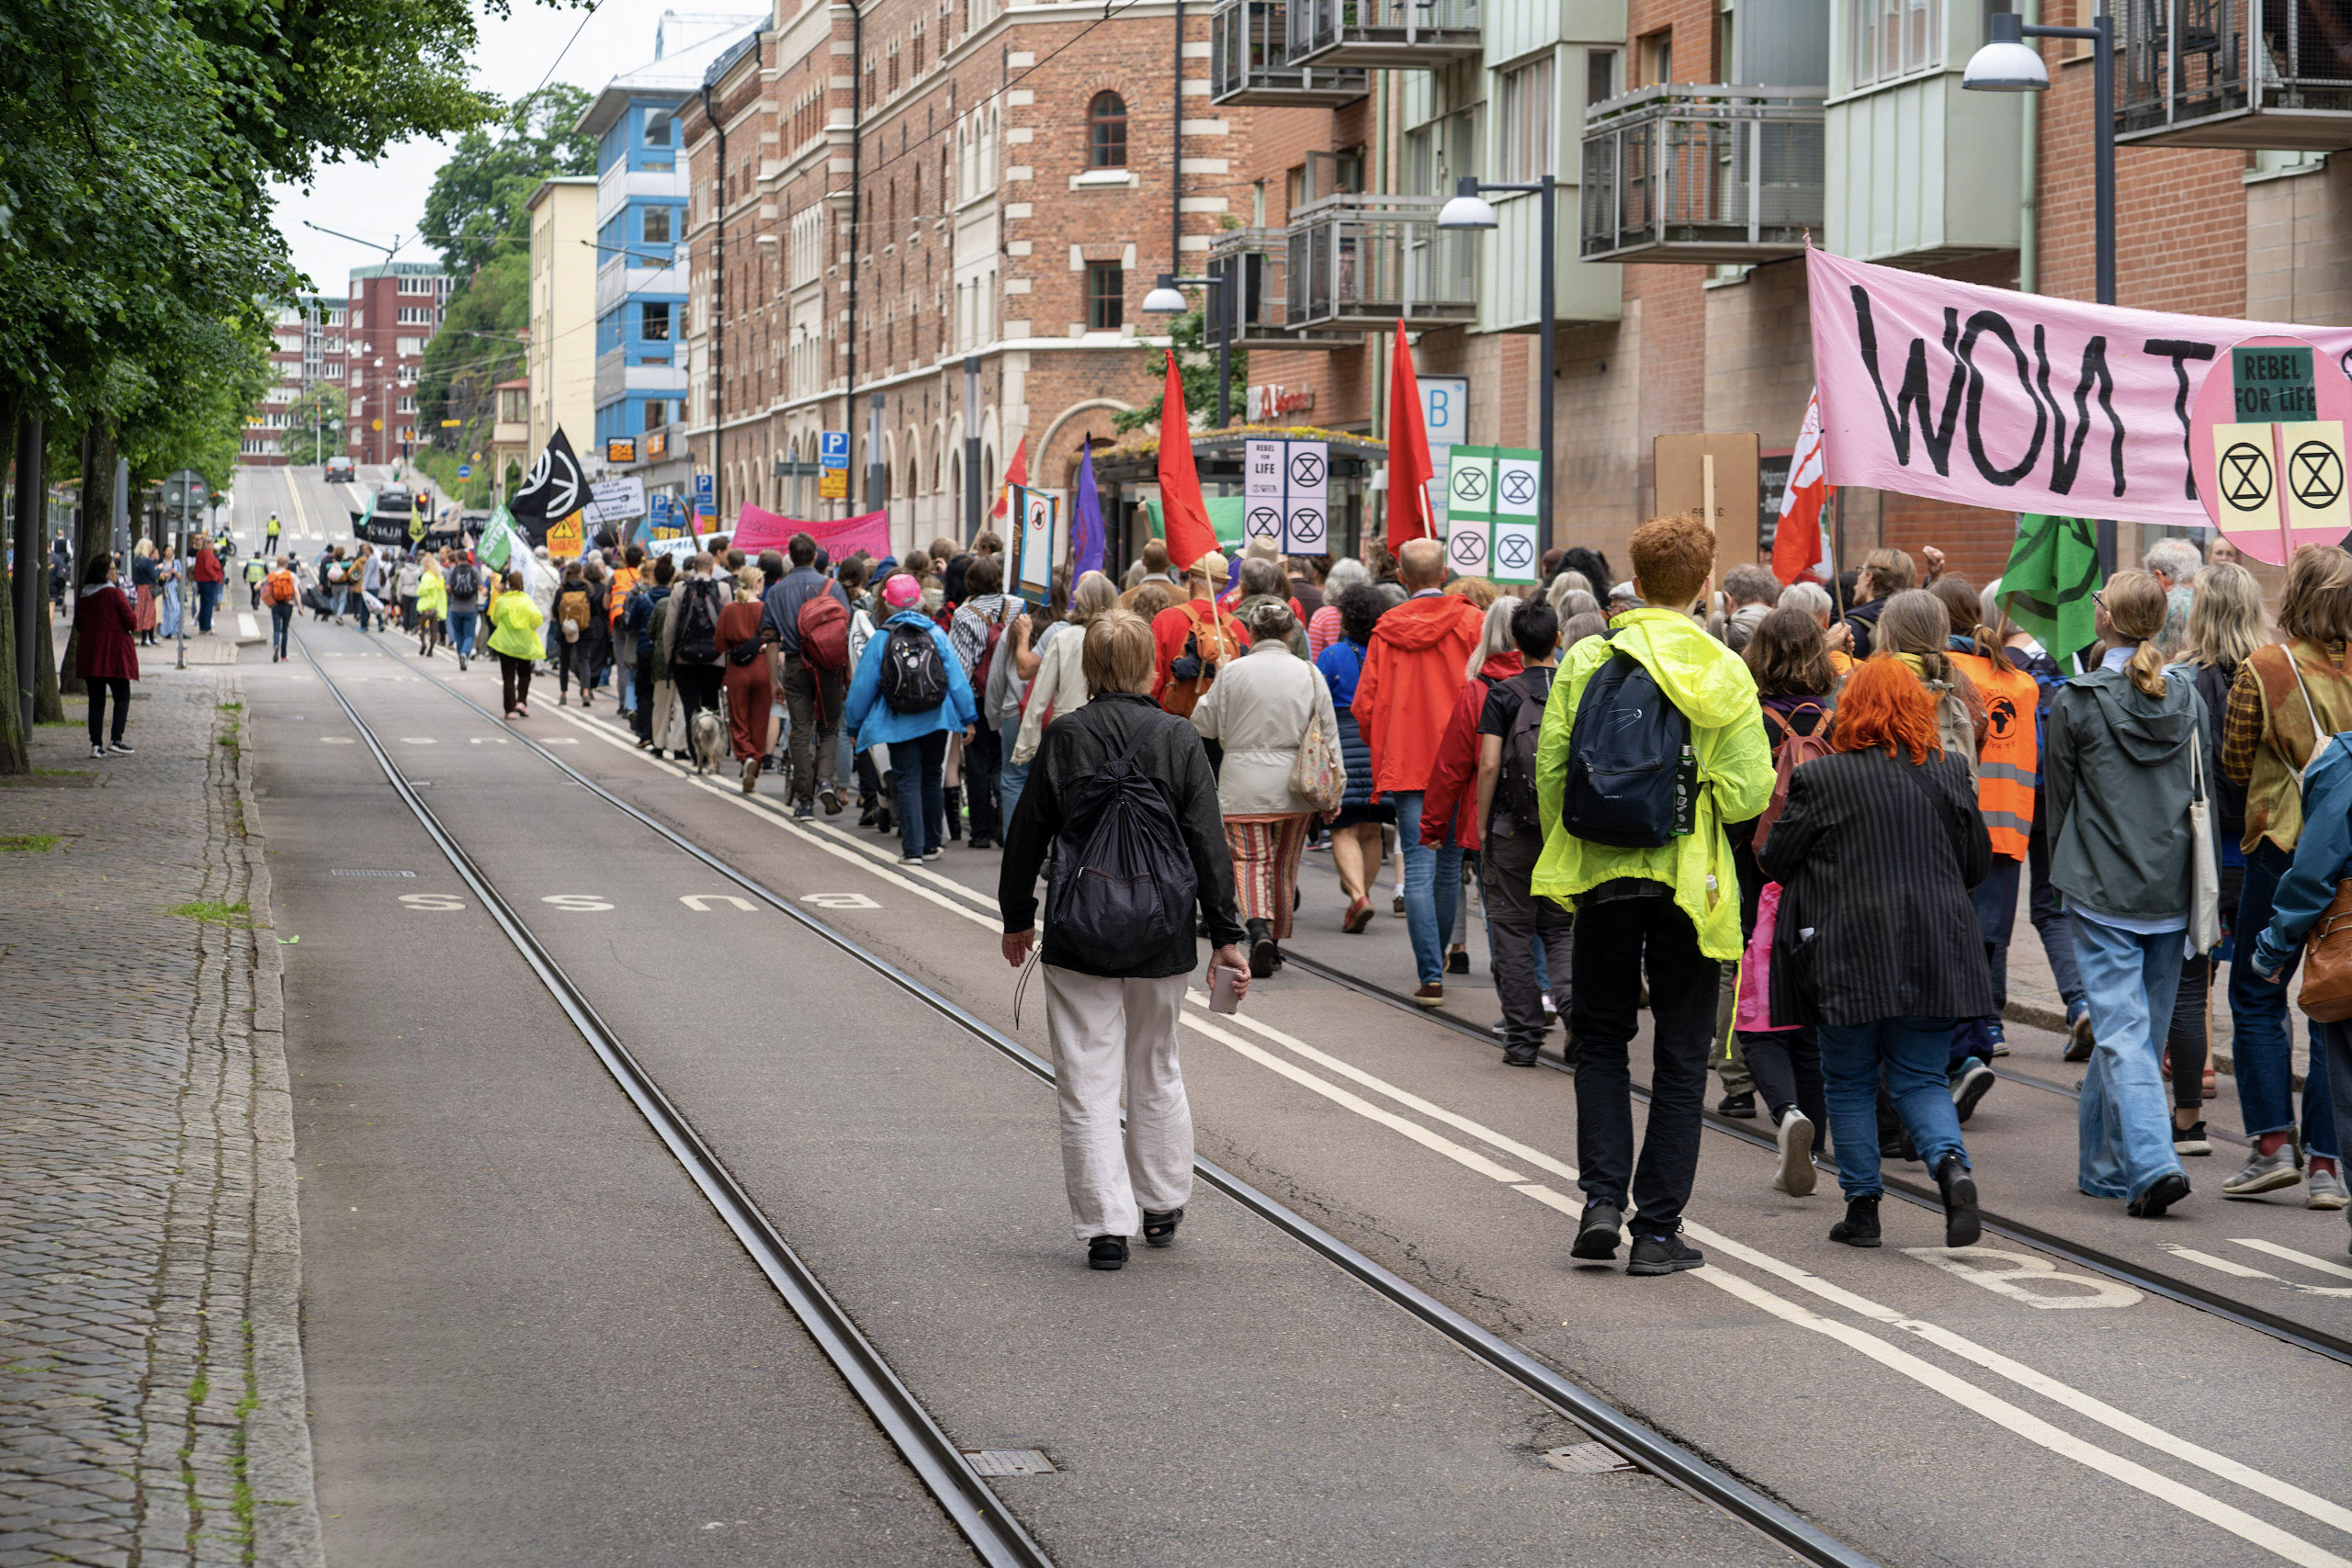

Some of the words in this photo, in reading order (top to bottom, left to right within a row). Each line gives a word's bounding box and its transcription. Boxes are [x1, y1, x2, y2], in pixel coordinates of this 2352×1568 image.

[2245, 355, 2301, 380] REBEL
[1430, 389, 1448, 427] B
[2234, 387, 2271, 412] FOR
[2278, 386, 2316, 412] LIFE
[829, 434, 842, 453] P
[1255, 463, 1275, 474] LIFE
[699, 476, 709, 491] P
[655, 496, 665, 511] P
[398, 892, 884, 912] BUSS
